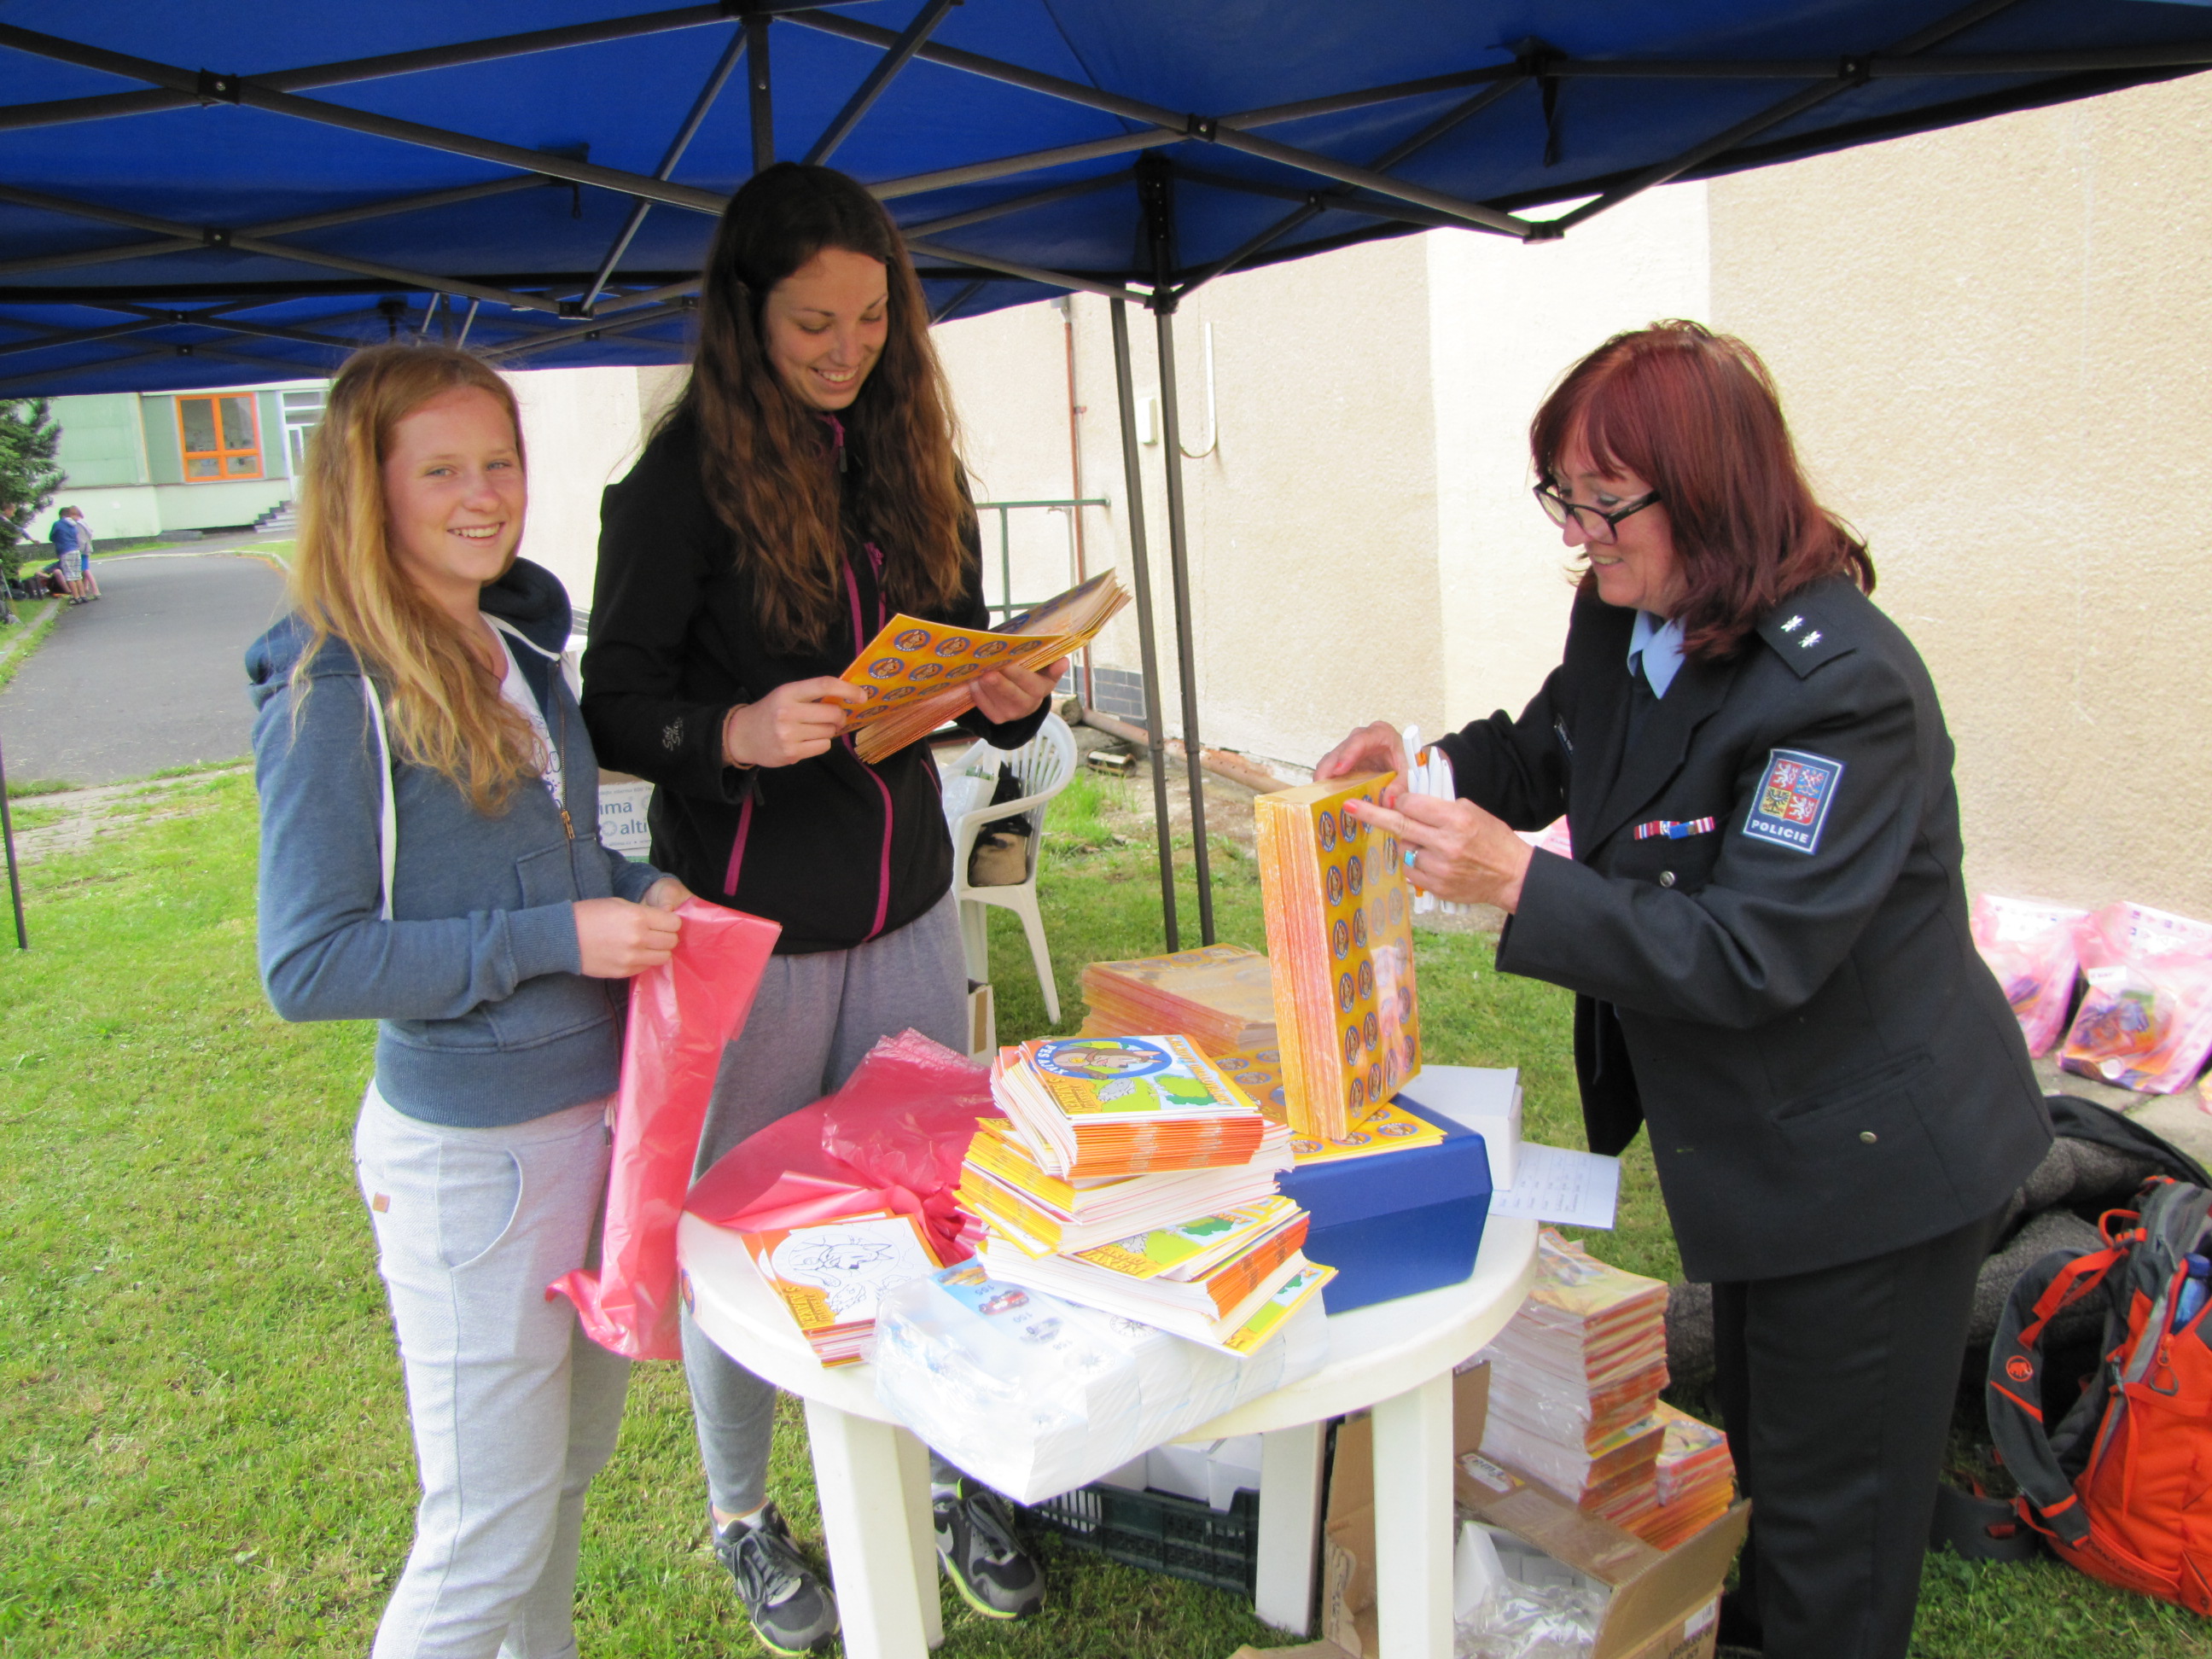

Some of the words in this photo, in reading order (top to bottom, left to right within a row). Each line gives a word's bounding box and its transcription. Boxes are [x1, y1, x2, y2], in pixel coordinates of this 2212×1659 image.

[600, 800, 633, 816] ima
[620, 818, 648, 835] alti
[1751, 819, 1809, 844] POLICIE
[1037, 1044, 1057, 1058] PES
[1037, 1059, 1069, 1075] AJAX
[1051, 1084, 1086, 1113] AJAXEM
[1078, 1249, 1147, 1276] JAXEM
[1101, 1244, 1147, 1265] BARVUJ
[788, 1294, 819, 1327] AJAXEM
